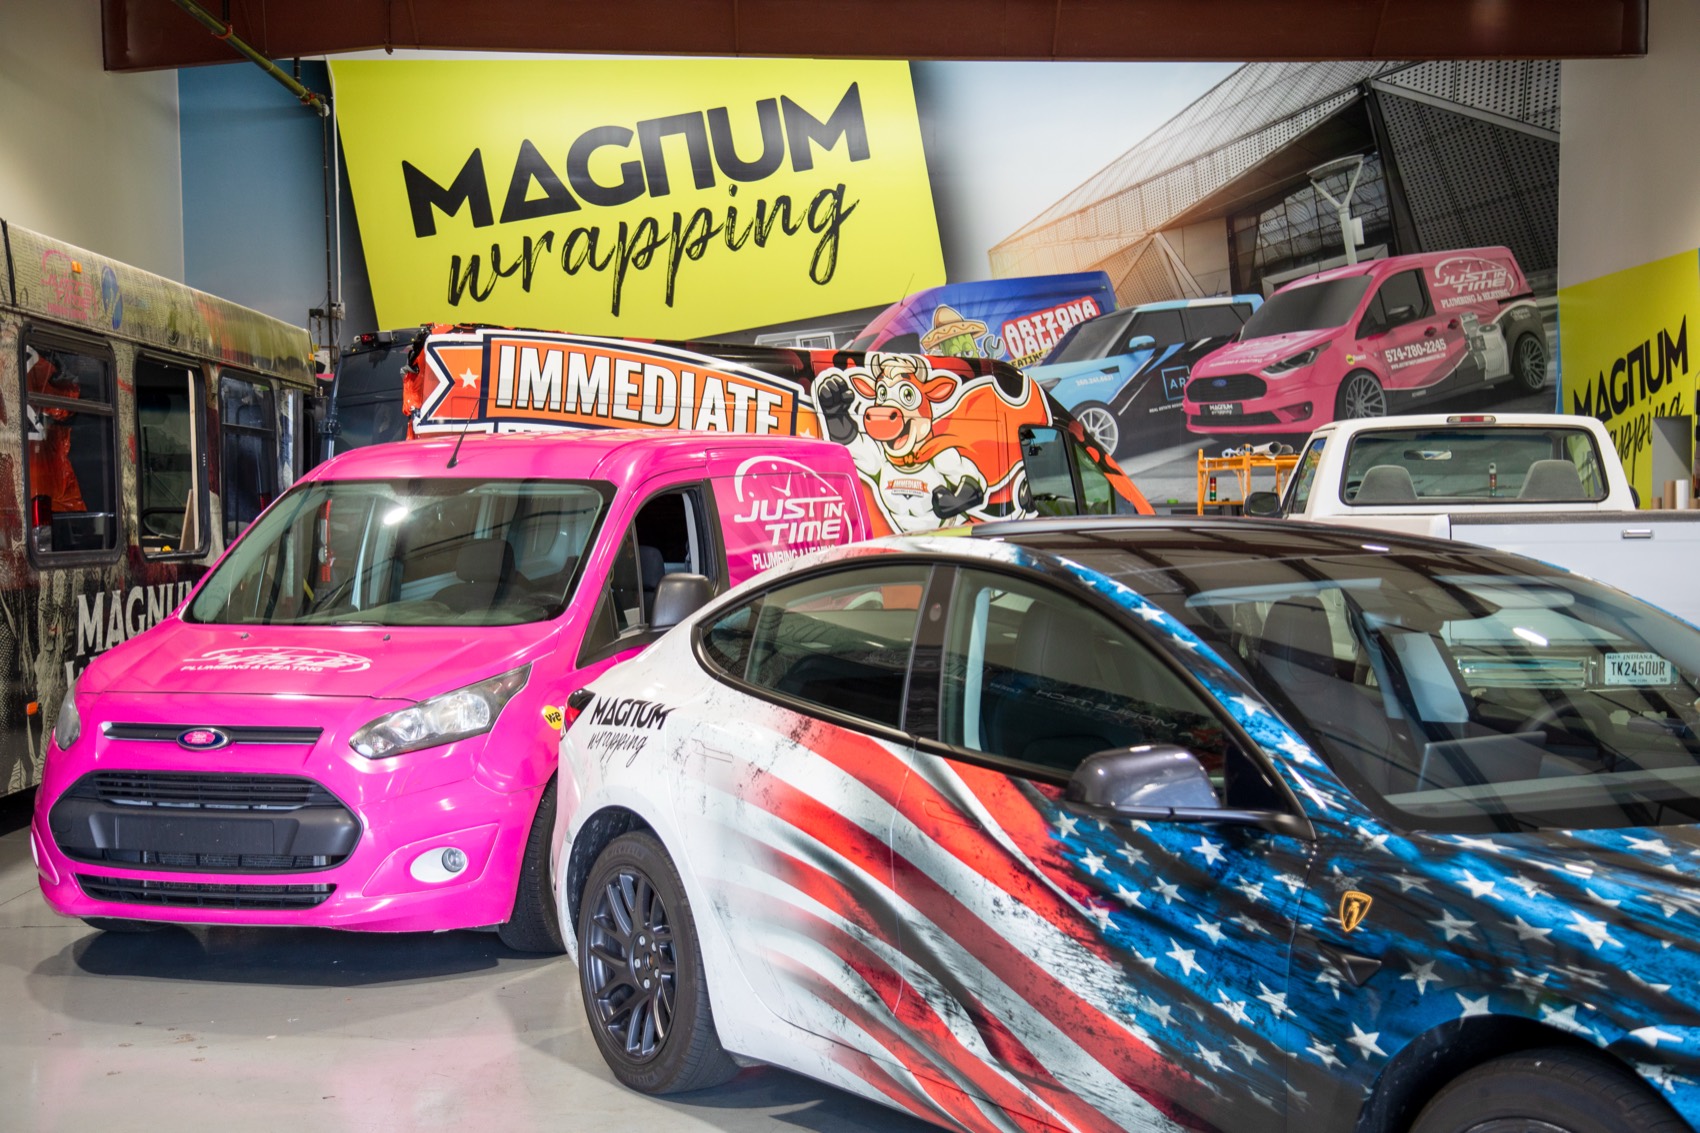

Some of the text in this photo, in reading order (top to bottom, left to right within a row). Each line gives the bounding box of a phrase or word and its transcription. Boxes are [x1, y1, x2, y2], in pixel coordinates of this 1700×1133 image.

[402, 82, 870, 238] MAGNUM
[447, 183, 860, 318] wrapping
[1434, 268, 1507, 287] JUST IN
[1452, 277, 1506, 294] TIME
[1441, 294, 1476, 309] PLUMBING
[1005, 299, 1097, 339] ARIZONA
[1384, 338, 1447, 363] 574-780-2245
[1573, 313, 1689, 424] MAGNUM
[495, 345, 783, 435] IMMEDIATE
[1170, 376, 1190, 390] AR
[734, 496, 845, 523] JUST IN
[765, 519, 842, 546] TIME
[262, 664, 323, 673] HEATING
[545, 711, 562, 724] we
[589, 696, 676, 730] MAGNUM
[587, 728, 648, 768] wrapping
